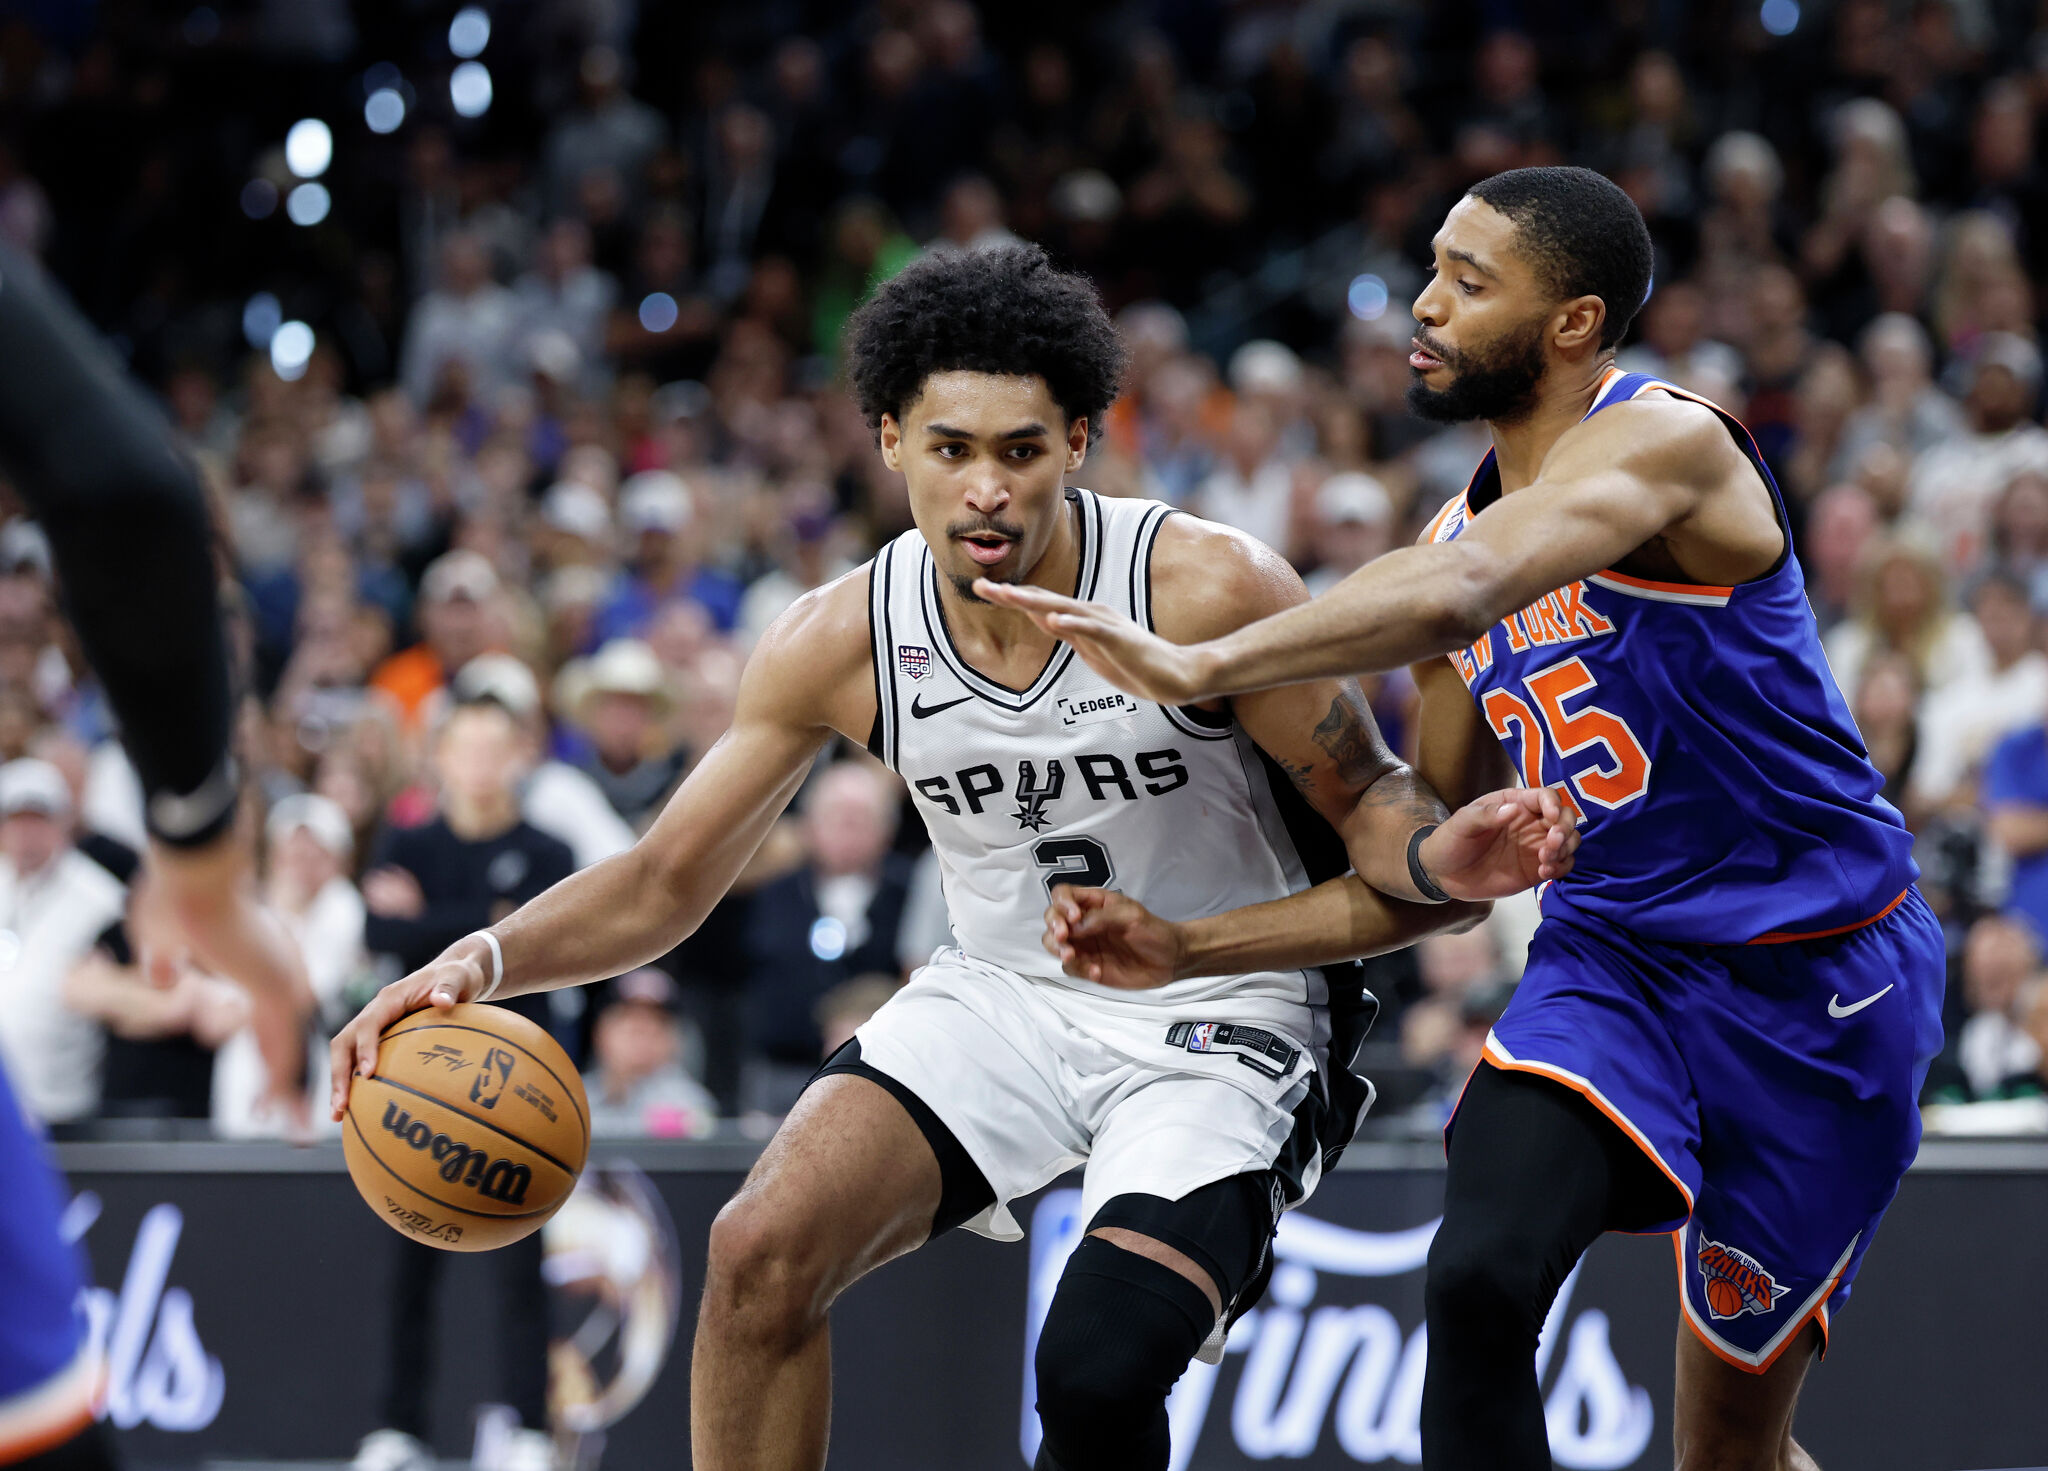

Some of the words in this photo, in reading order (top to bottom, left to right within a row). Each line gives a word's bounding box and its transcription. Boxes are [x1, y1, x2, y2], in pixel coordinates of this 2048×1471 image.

[900, 648, 928, 658] USA
[900, 662, 931, 674] 250
[1069, 694, 1125, 716] LEDGER
[1481, 656, 1651, 822] 25
[914, 748, 1190, 833] SPURS
[382, 1099, 532, 1206] Wilson
[1698, 1245, 1772, 1310] KNICKS
